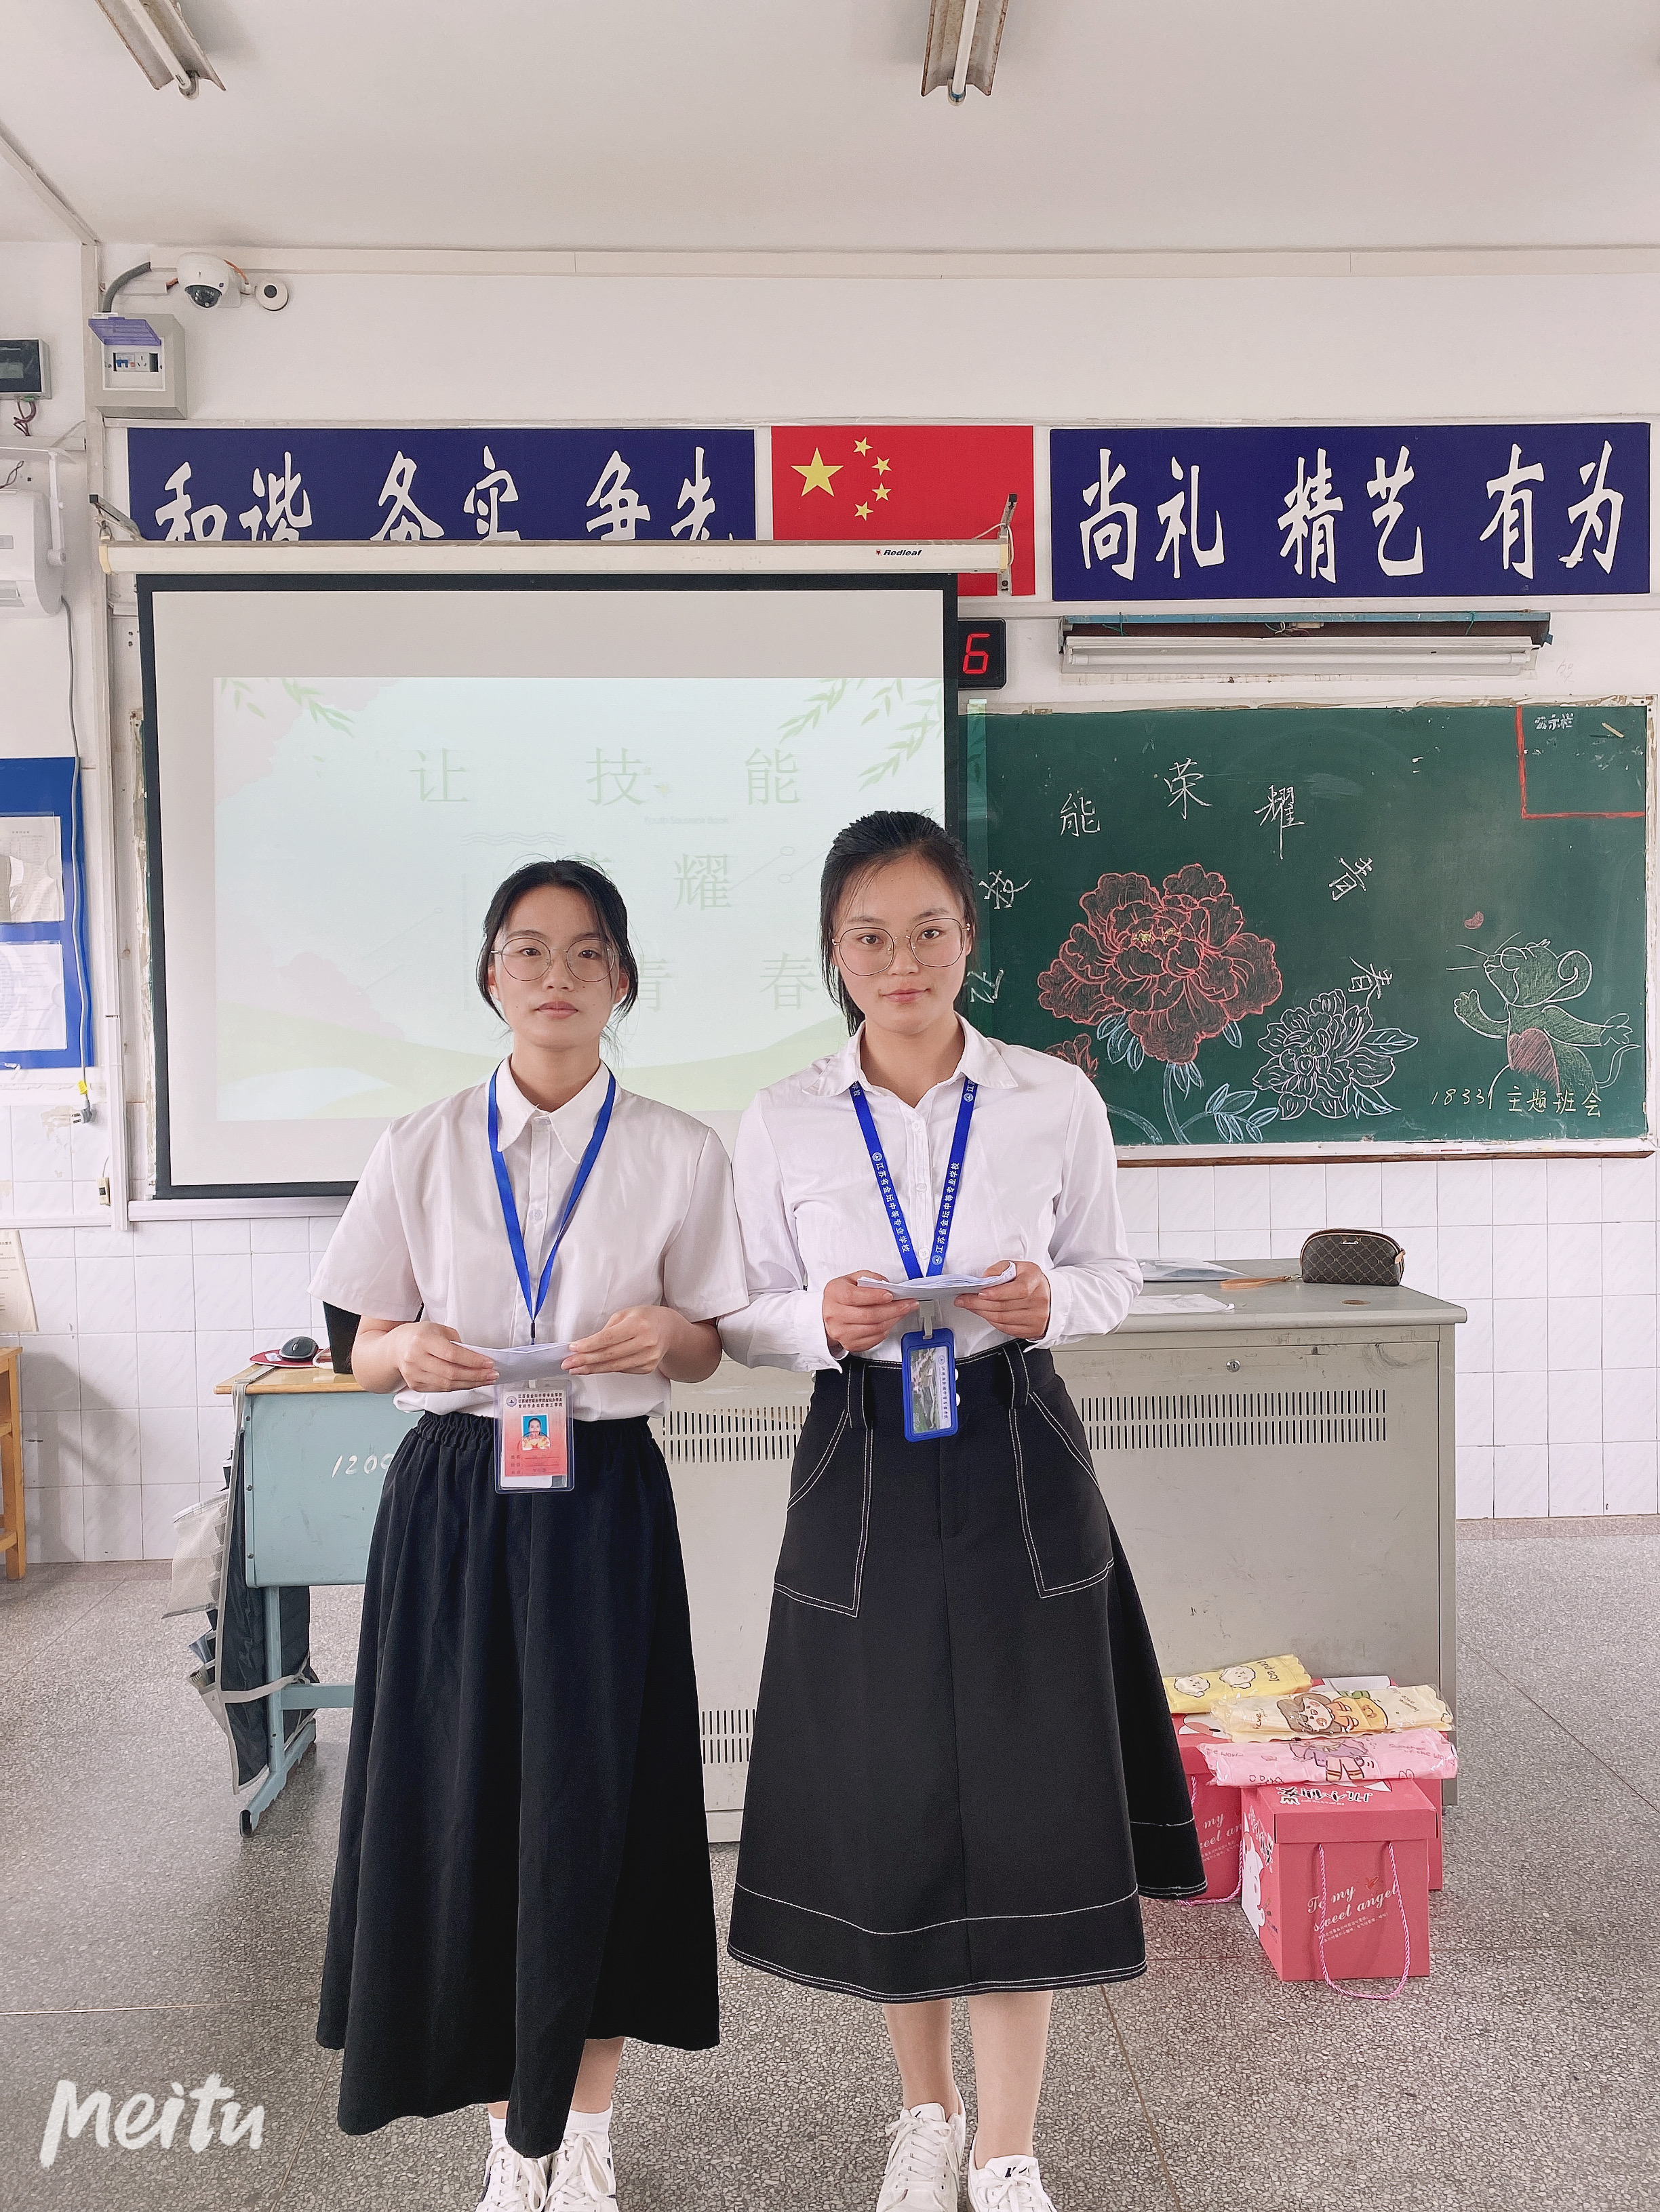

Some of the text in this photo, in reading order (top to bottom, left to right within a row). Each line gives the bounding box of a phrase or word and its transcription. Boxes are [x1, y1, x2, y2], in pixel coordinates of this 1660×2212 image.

[1080, 441, 1624, 583] 尚礼 精艺 有为
[962, 633, 990, 674] 6
[1535, 713, 1574, 730] 公示栏
[1507, 1085, 1602, 1118] 主题班会
[875, 1162, 909, 1253] 江苏省金坛中等专业学校
[935, 1161, 960, 1254] 江苏省金坛中等专业学校
[1331, 1886, 1356, 1903] my
[1357, 1883, 1398, 1912] angel
